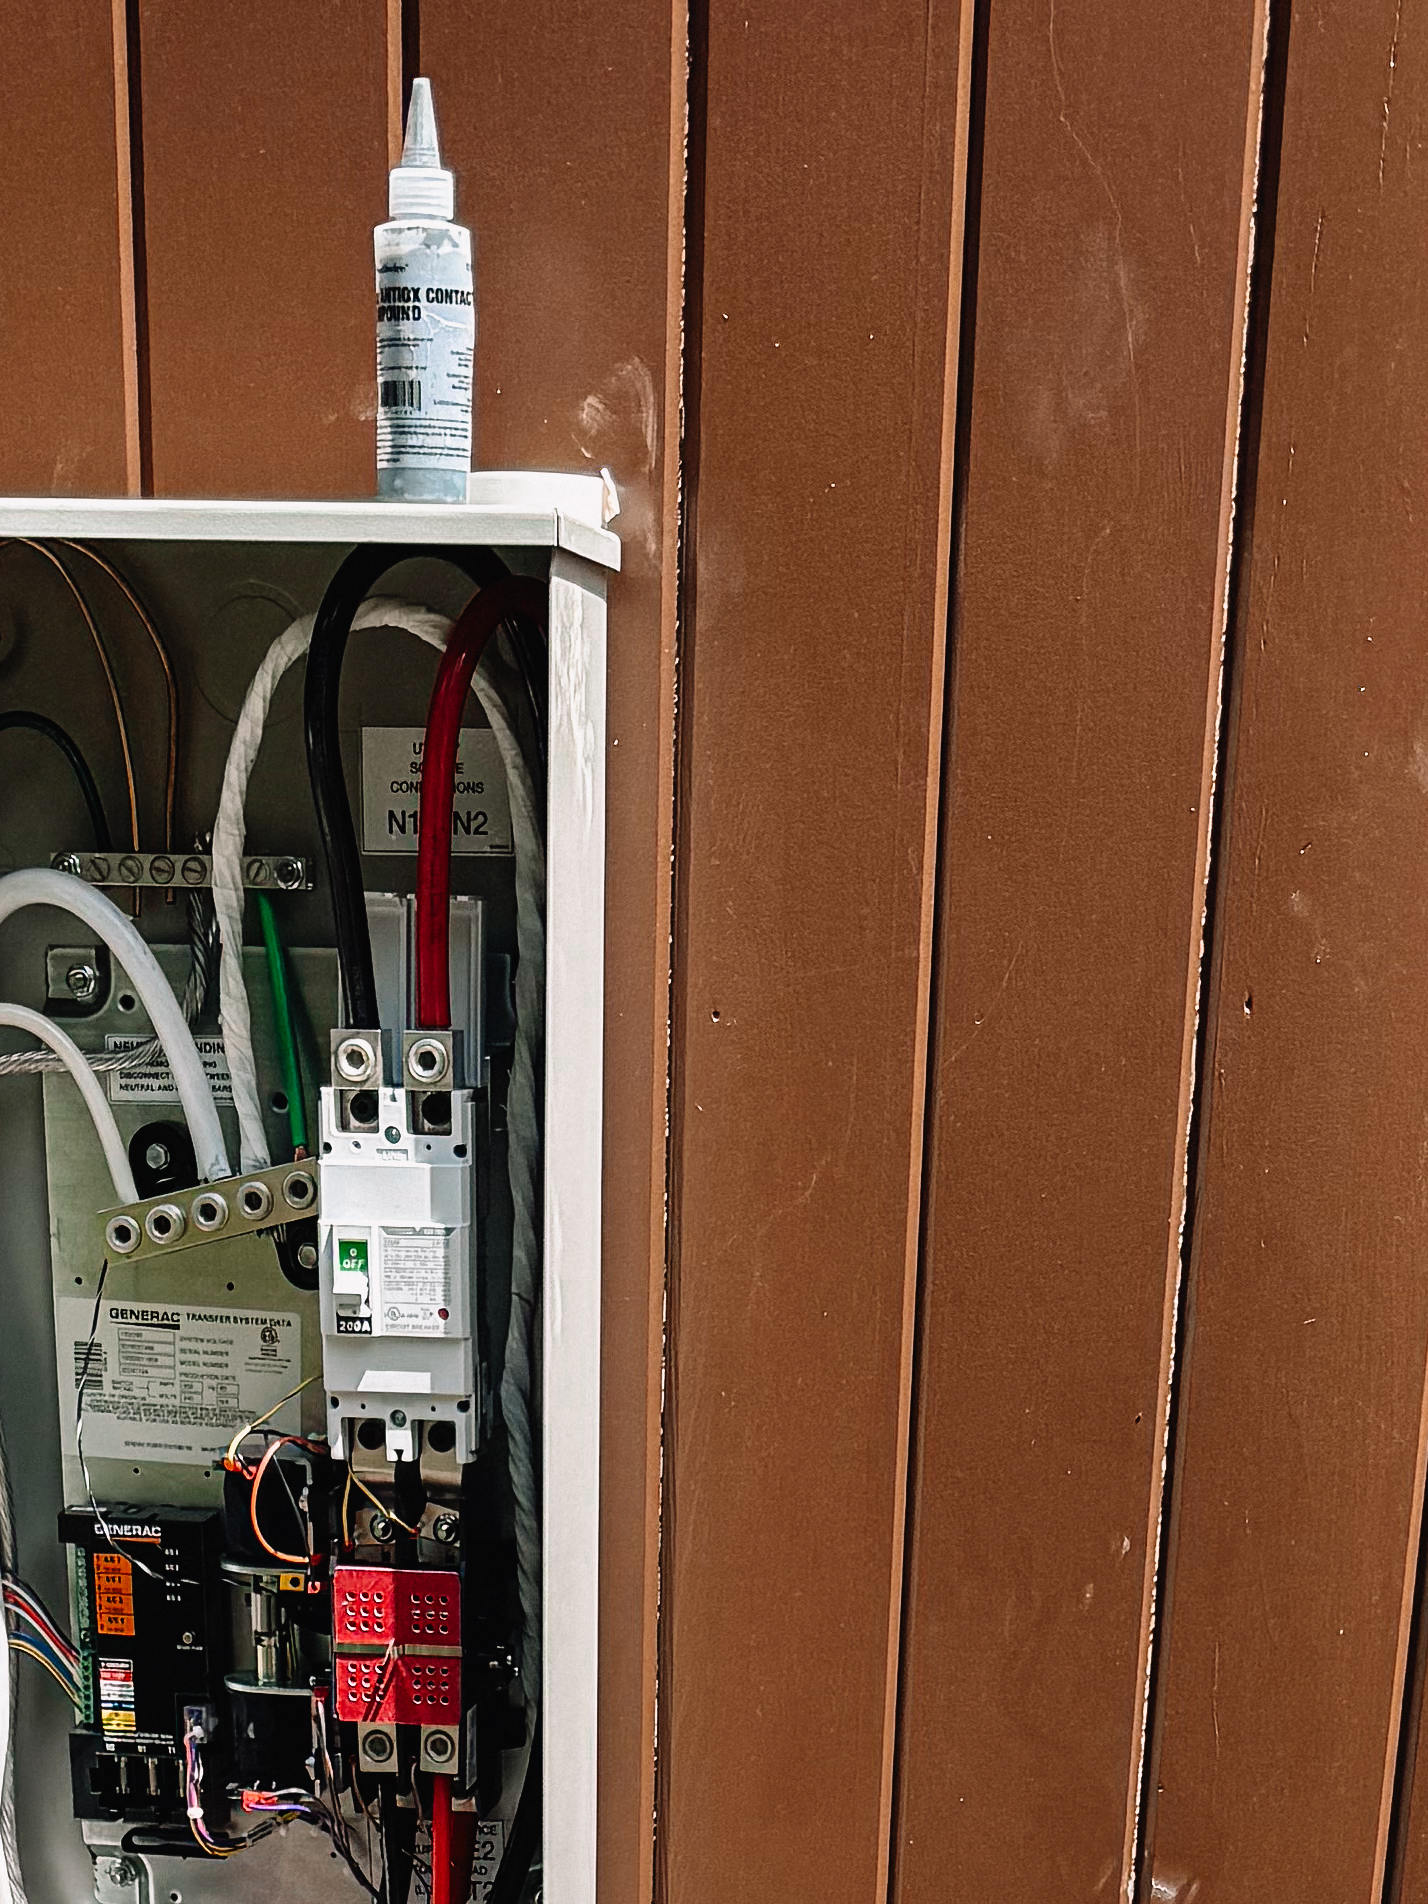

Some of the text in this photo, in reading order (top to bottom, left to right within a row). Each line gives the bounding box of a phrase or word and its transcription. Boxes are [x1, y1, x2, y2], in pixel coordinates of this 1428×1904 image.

[343, 1258, 363, 1269] OFF
[110, 1307, 180, 1323] GENERAC
[187, 1312, 232, 1324] TRANSFER
[339, 1321, 371, 1332] 200A
